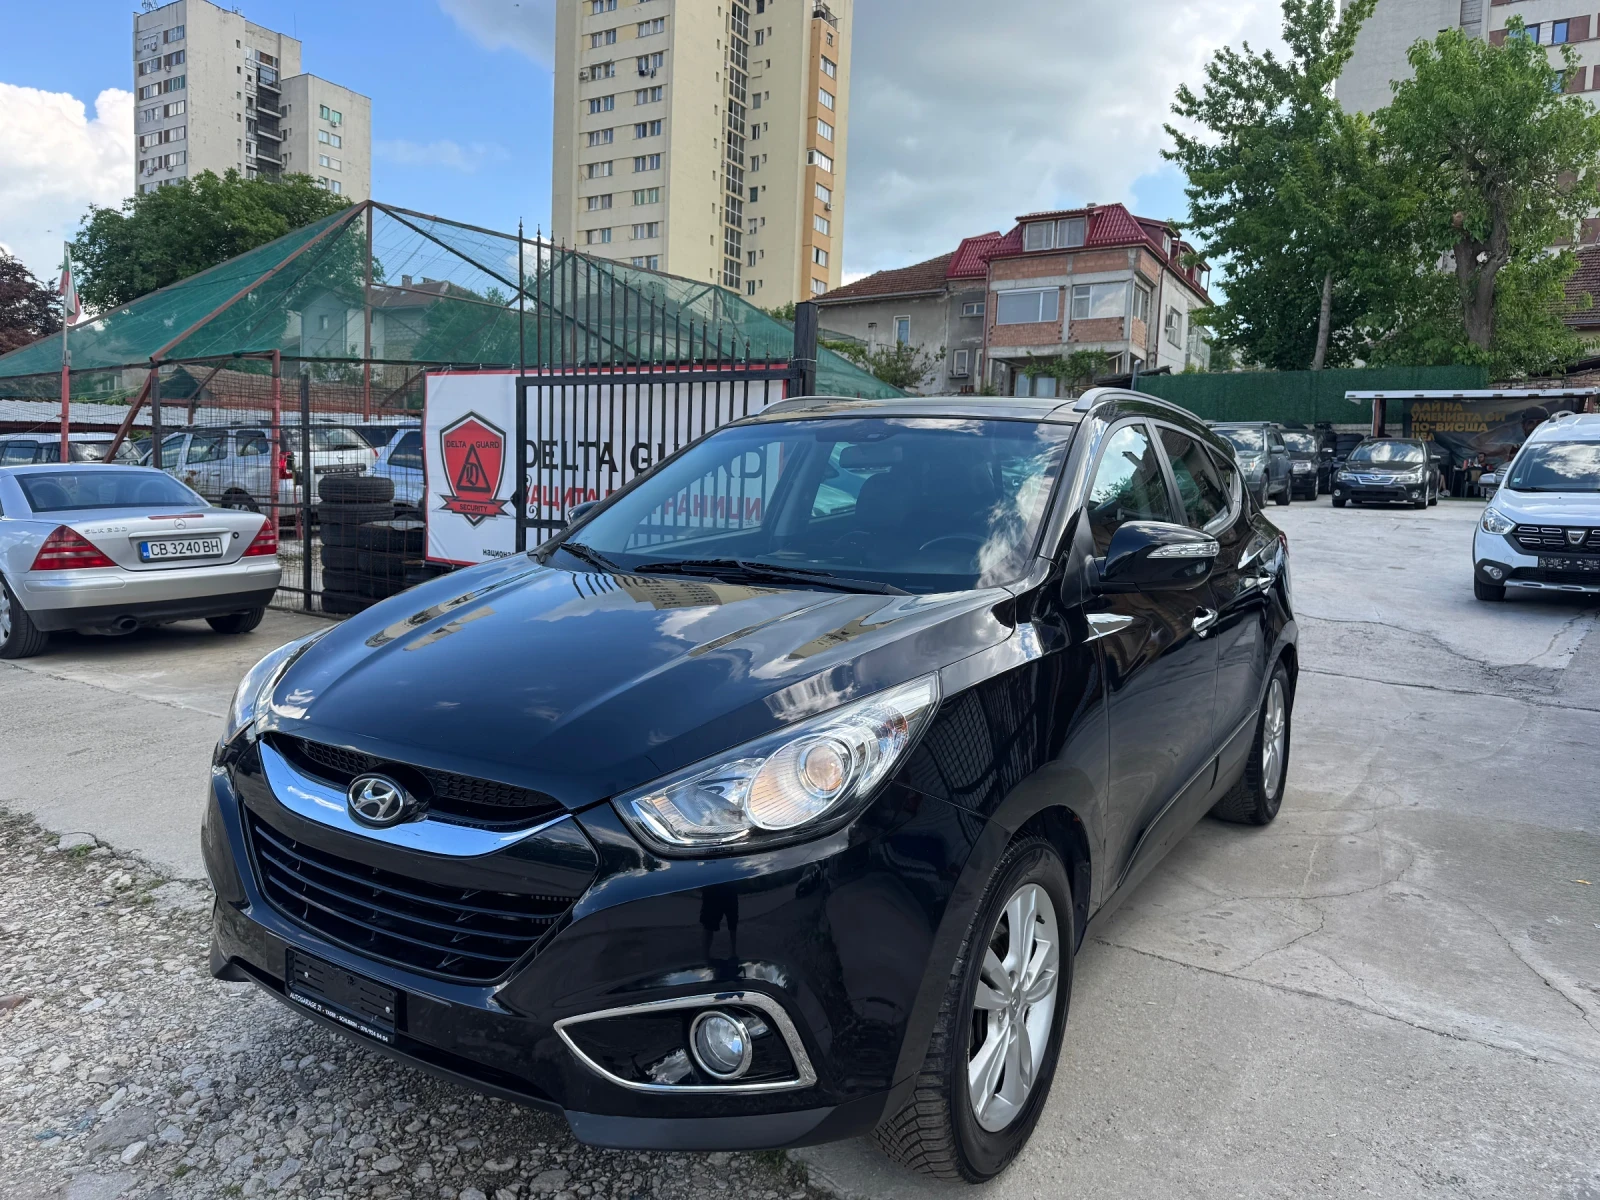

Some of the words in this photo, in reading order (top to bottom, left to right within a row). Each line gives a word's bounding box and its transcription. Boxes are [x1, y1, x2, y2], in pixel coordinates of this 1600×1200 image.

[1411, 401, 1440, 412] ДАЙ
[1444, 402, 1463, 411] НА
[1411, 411, 1482, 422] УМЕНИЯТА
[1411, 422, 1488, 432] ПО-ВИСША
[446, 440, 467, 448] DELTA
[475, 441, 500, 449] GUARD
[523, 440, 618, 473] DELTA
[459, 503, 488, 513] SECURITY
[150, 543, 168, 556] CB
[170, 541, 201, 555] 3240
[202, 540, 220, 553] BH
